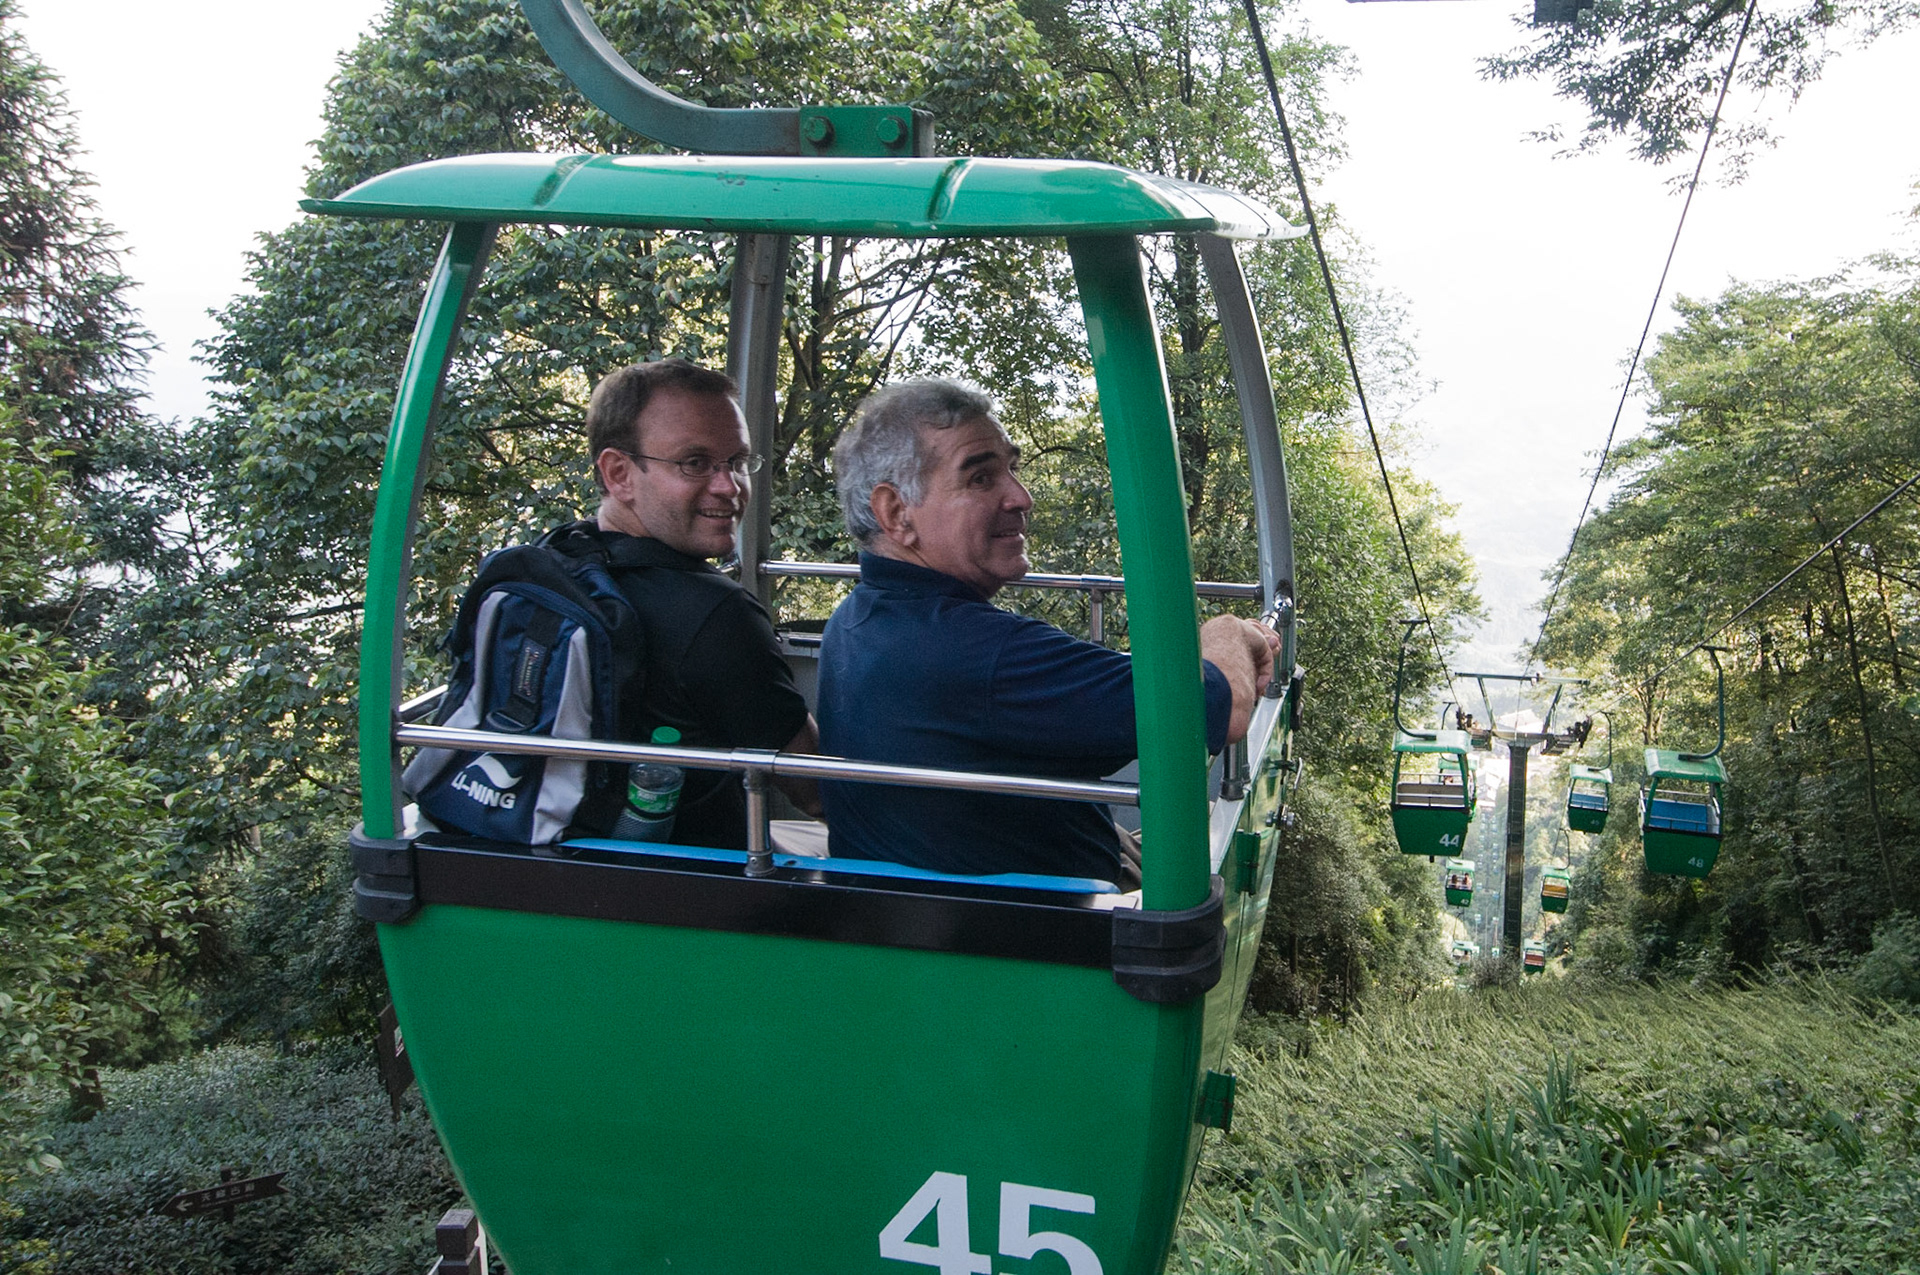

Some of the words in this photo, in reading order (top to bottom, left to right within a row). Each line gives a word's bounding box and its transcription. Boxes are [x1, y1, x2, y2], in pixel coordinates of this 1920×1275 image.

[1438, 832, 1460, 848] 44
[1687, 855, 1704, 869] 48
[879, 1171, 1104, 1275] 45
